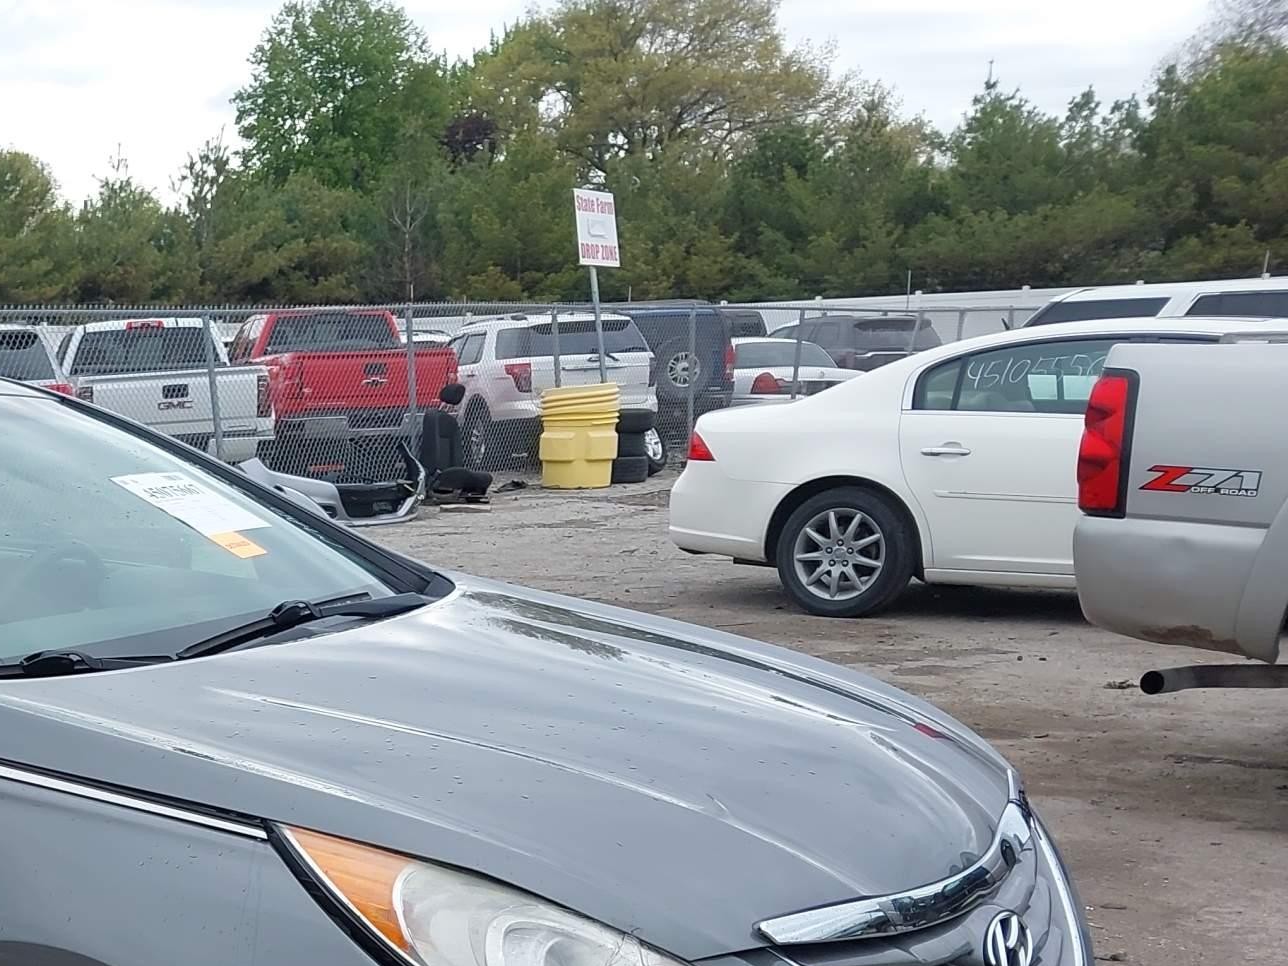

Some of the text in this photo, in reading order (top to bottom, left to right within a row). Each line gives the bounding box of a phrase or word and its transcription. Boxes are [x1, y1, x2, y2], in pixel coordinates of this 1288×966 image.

[576, 195, 614, 215] State Farm
[581, 243, 618, 261] DROP ZONE
[157, 400, 194, 411] GMC
[1138, 464, 1263, 493] Z71
[1191, 486, 1257, 497] OFF ROAD
